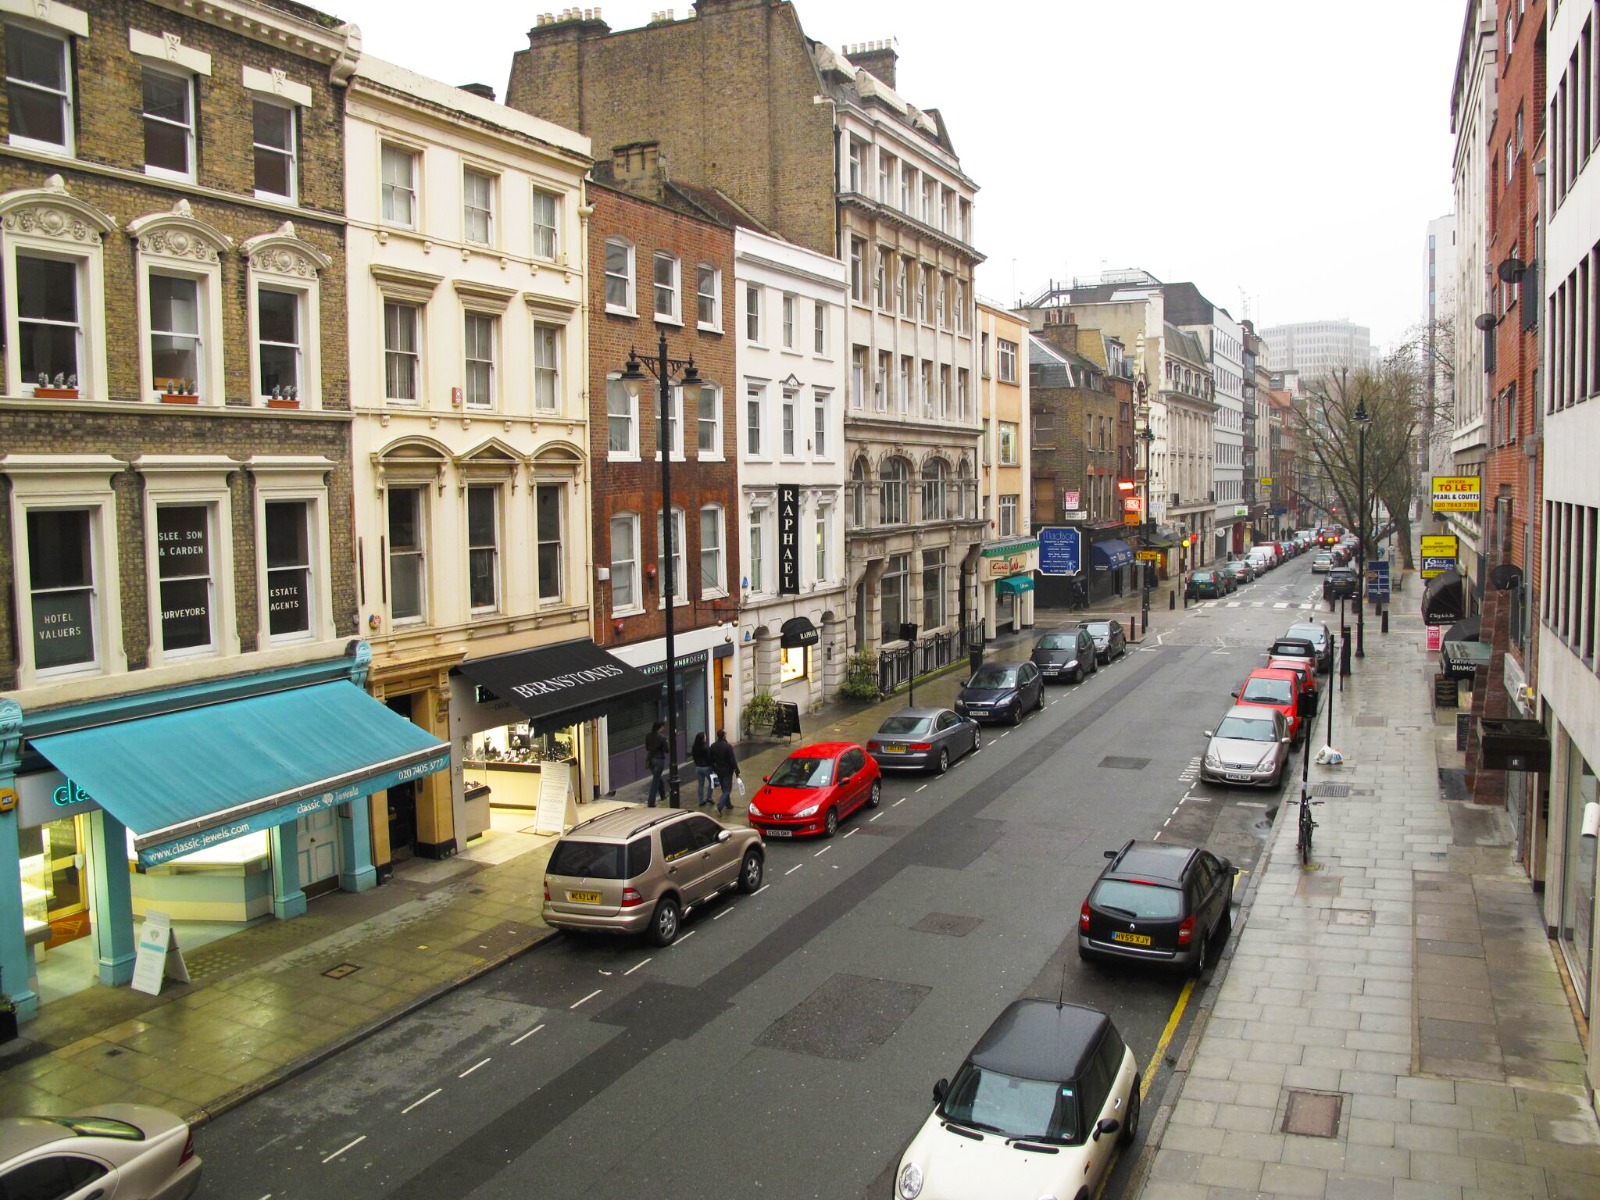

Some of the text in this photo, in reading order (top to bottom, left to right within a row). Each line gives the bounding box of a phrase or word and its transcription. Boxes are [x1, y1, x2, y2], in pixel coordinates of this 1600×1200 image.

[187, 531, 203, 540] SON
[783, 489, 794, 589] RAPHAEL
[159, 546, 204, 556] & CARDEN
[270, 587, 298, 597] ESTATE
[270, 601, 299, 611] AGENTS
[44, 613, 73, 624] HOTEL
[39, 626, 81, 640] VALUERS
[511, 664, 624, 698] BERNSTONES
[399, 758, 443, 780] 020 7405 3777
[297, 787, 358, 814] classic jewels
[149, 823, 250, 861] www.classic-jewels.com
[1135, 936, 1149, 944] XJY
